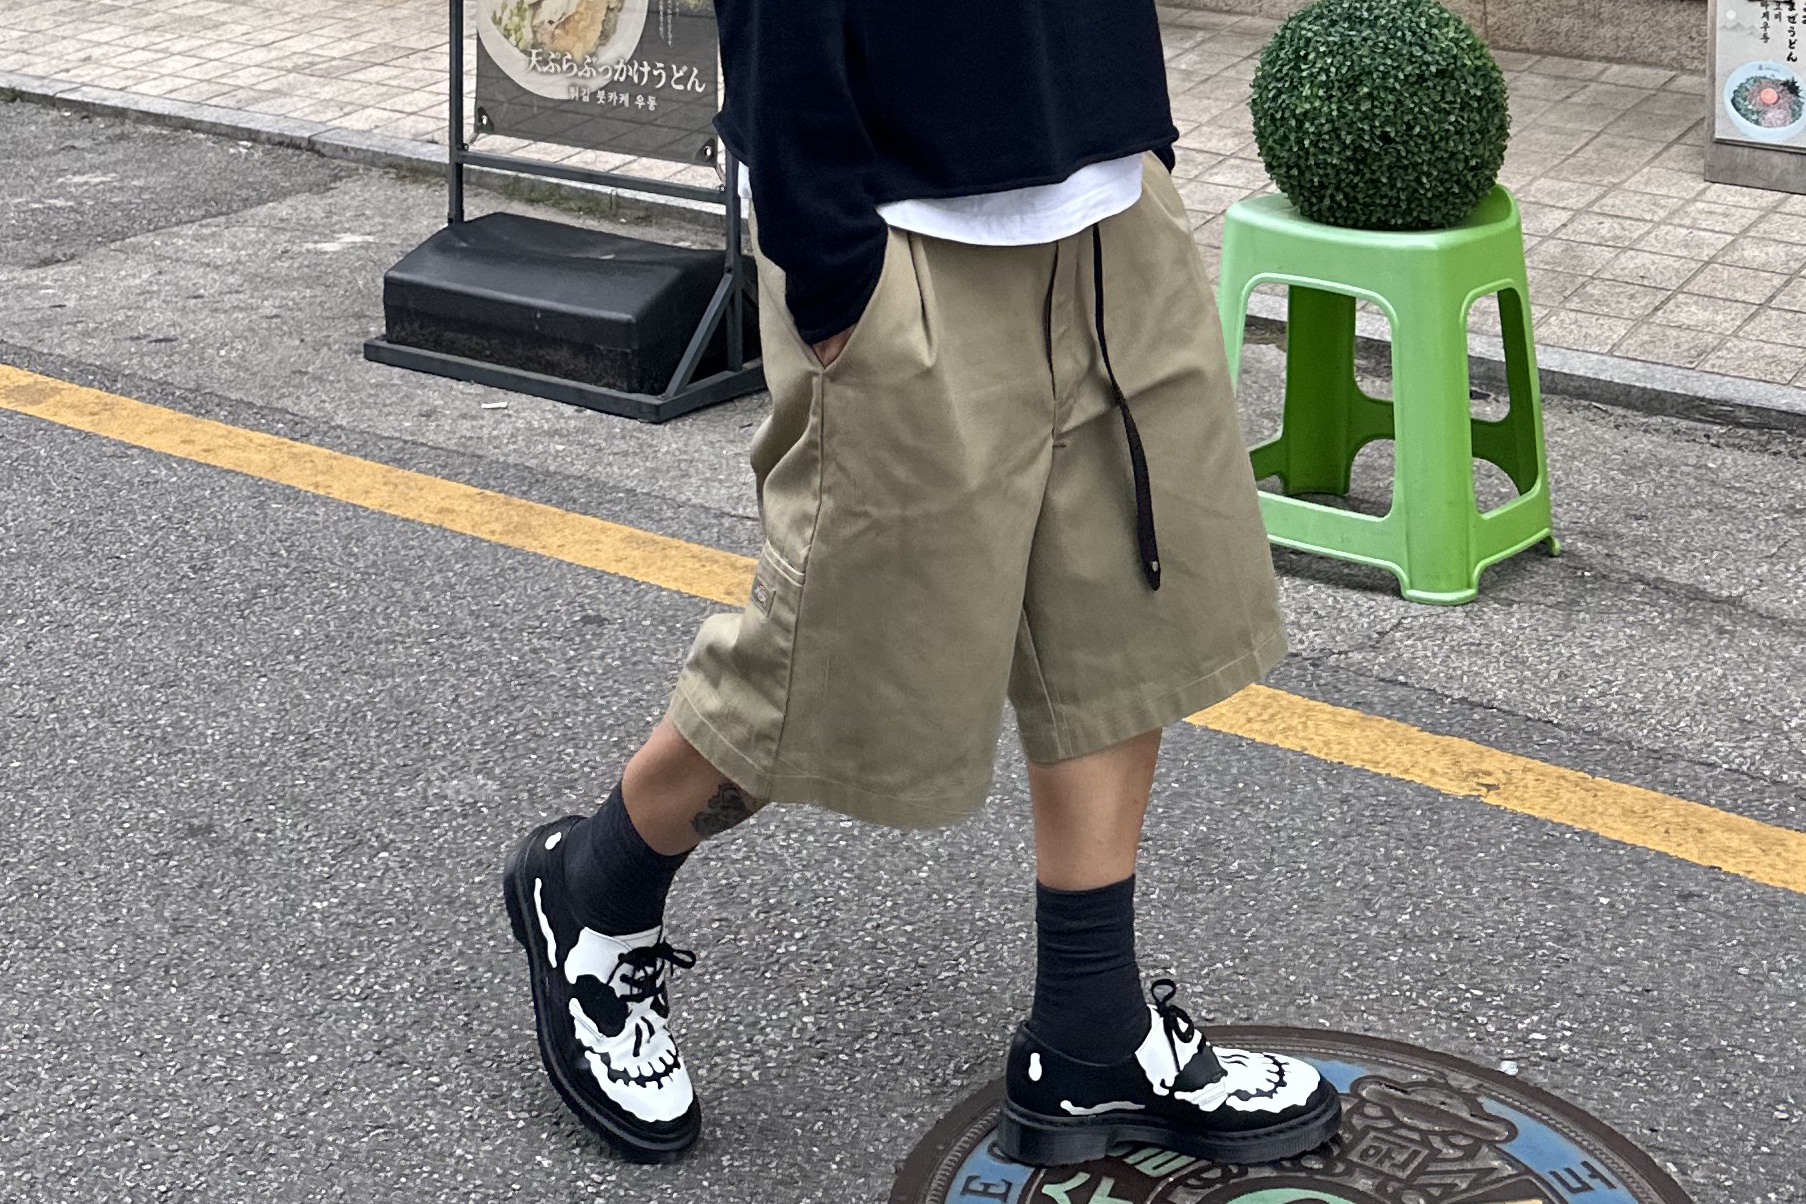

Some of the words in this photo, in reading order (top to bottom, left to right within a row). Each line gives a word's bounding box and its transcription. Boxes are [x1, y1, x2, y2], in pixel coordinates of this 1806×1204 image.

[526, 48, 707, 94] 天ぷらぶっかけうどん
